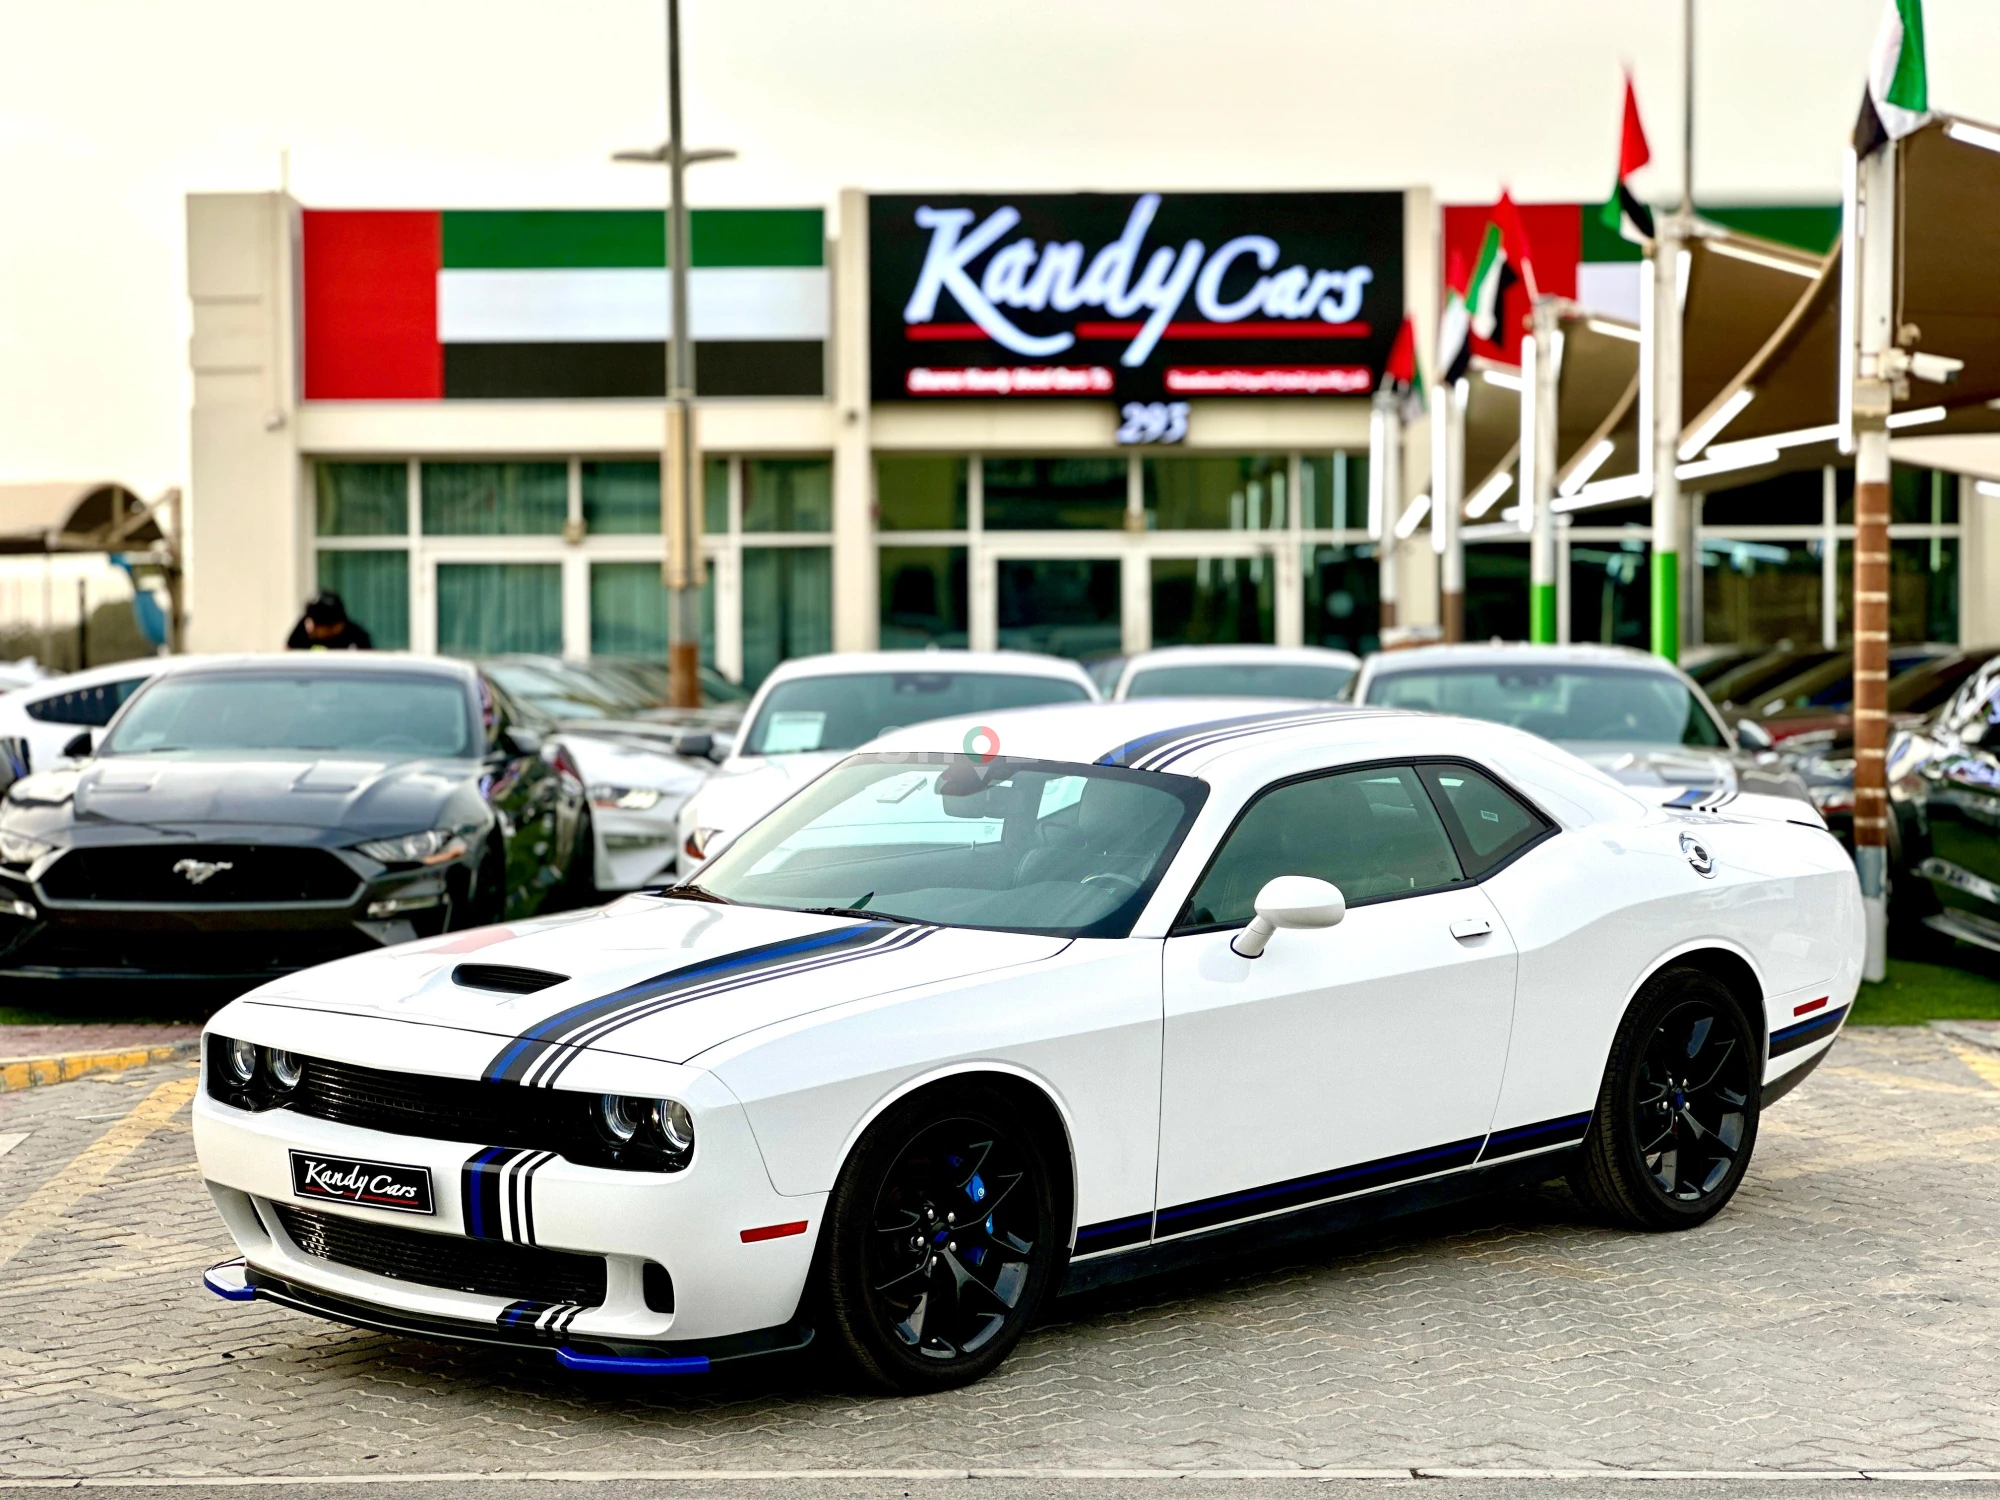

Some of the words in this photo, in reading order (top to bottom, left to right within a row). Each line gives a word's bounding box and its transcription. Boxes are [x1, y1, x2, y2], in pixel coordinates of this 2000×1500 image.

[904, 192, 1205, 367] Kandy
[1195, 235, 1373, 323] Cars
[304, 1160, 369, 1200] Kandy
[369, 1175, 417, 1197] Cars
